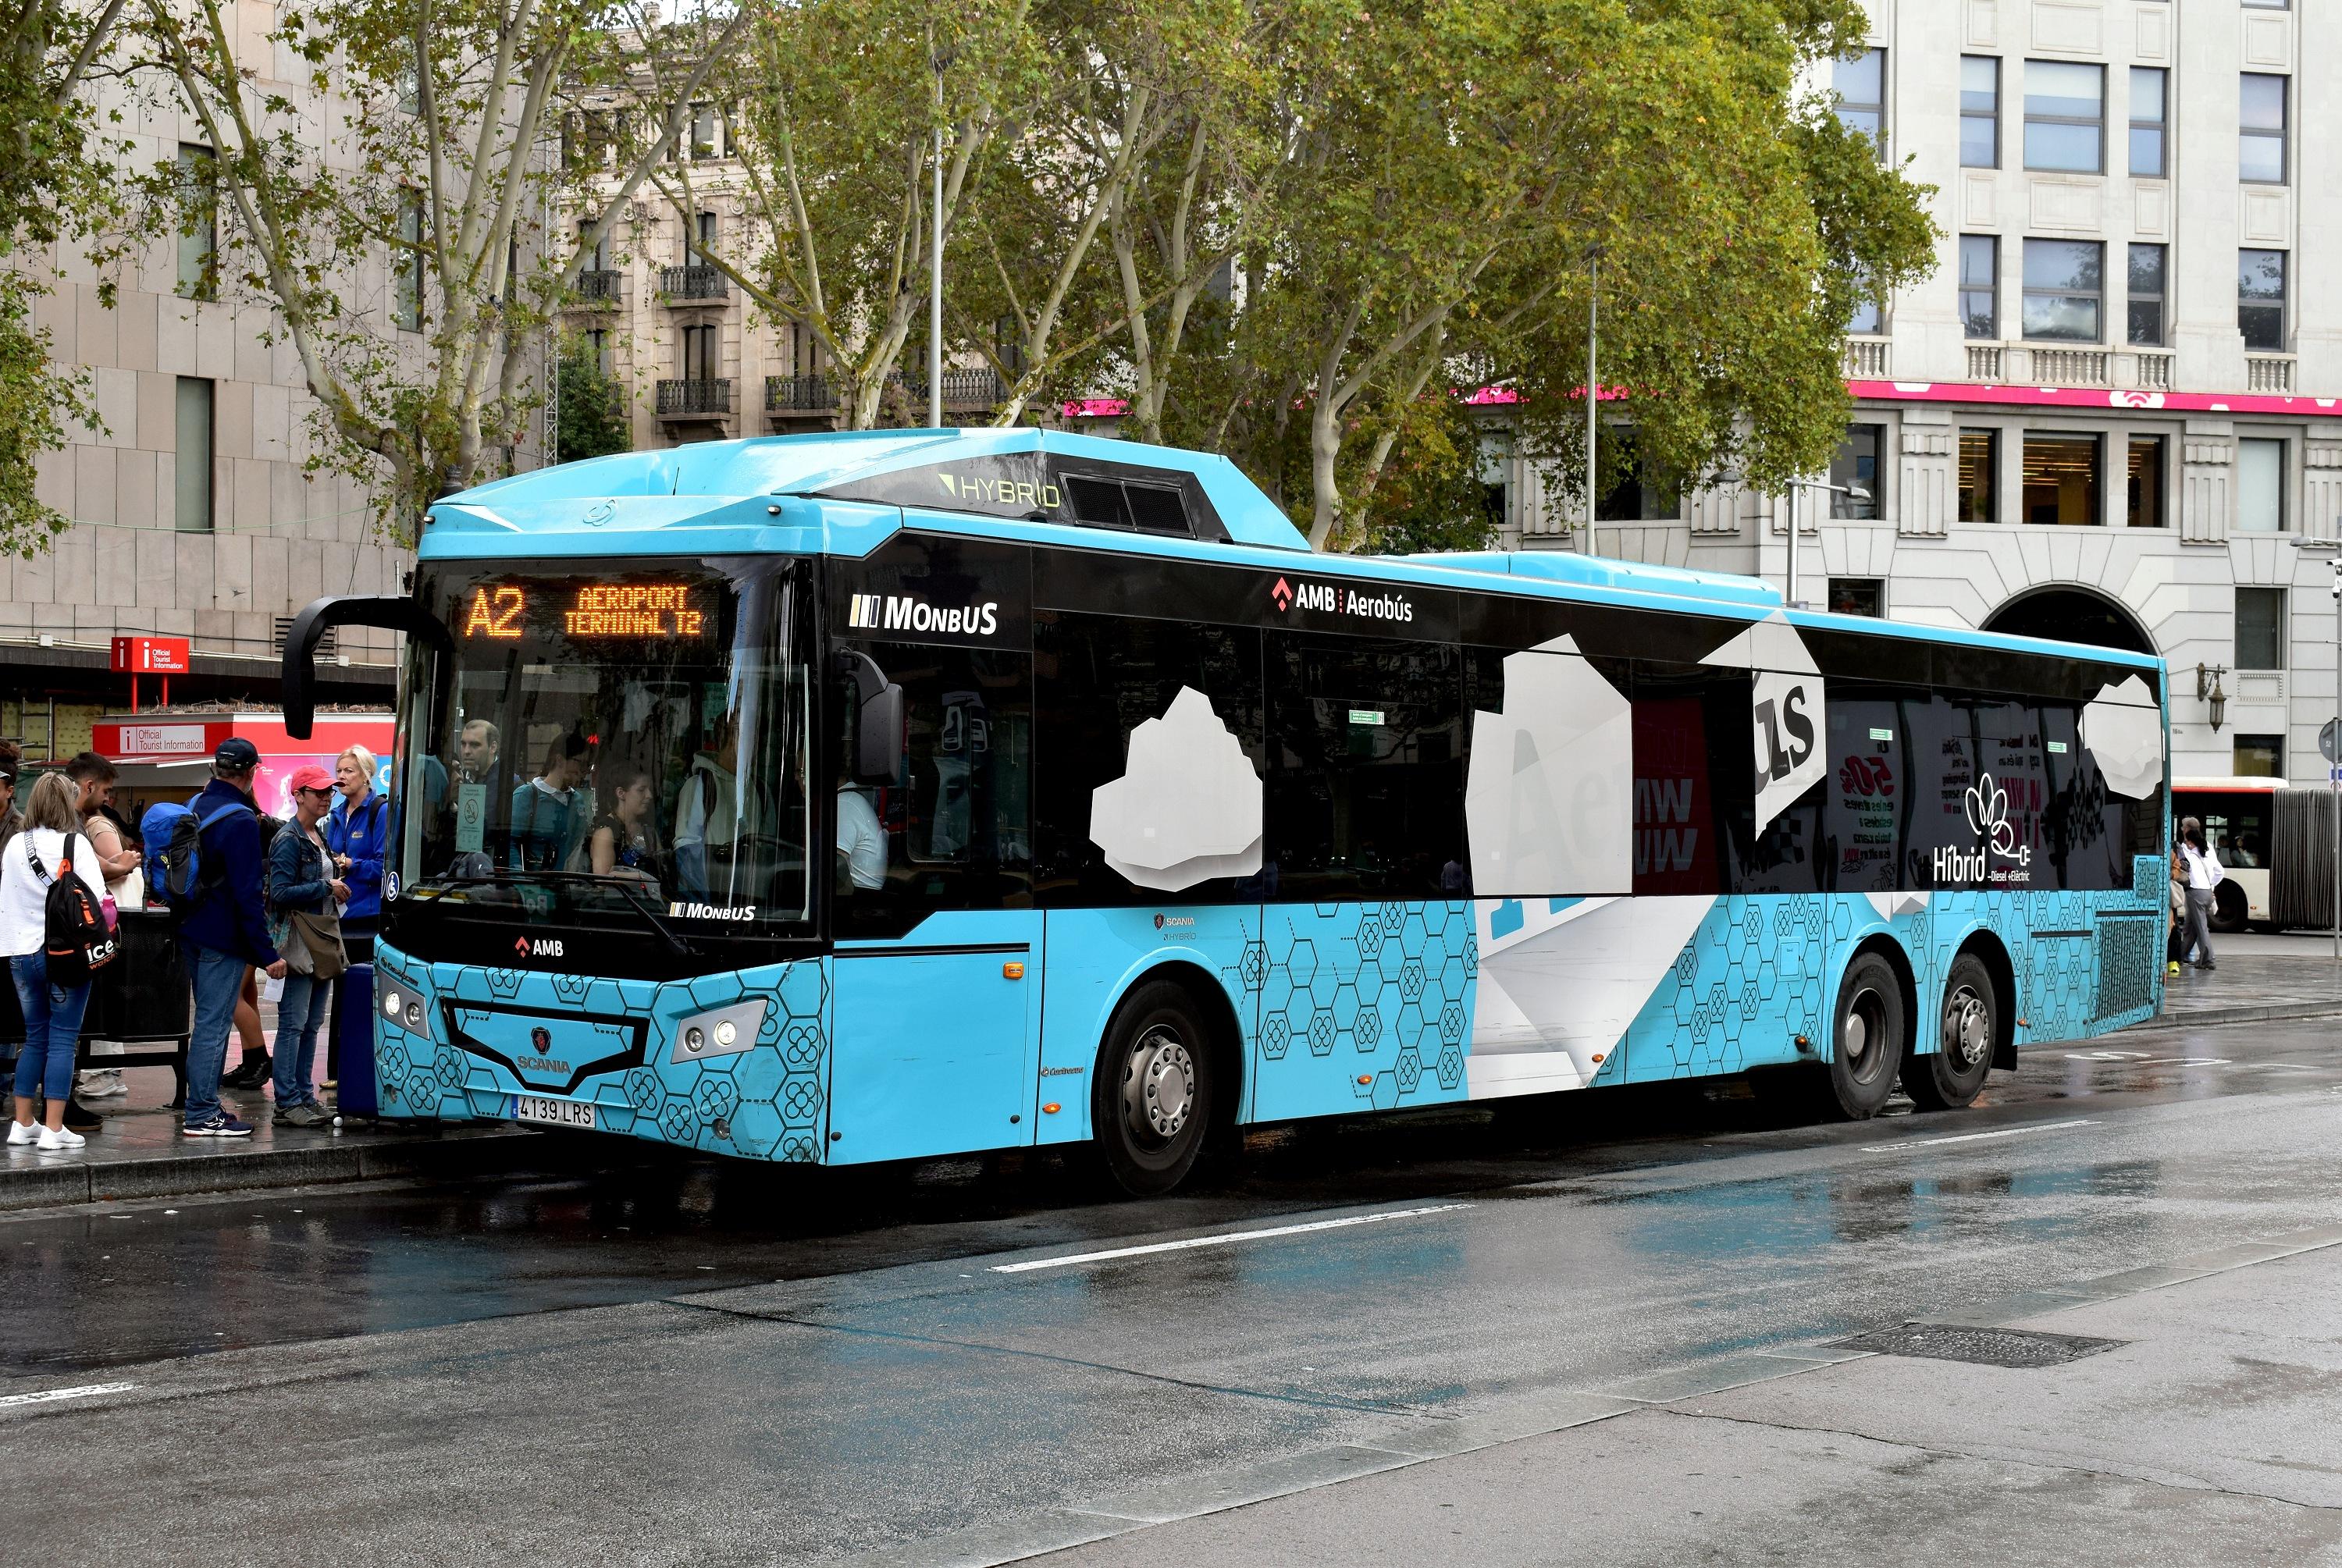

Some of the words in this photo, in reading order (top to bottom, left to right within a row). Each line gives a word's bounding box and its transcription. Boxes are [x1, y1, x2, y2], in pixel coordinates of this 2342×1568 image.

[961, 476, 1060, 508] HYBRID
[578, 586, 687, 610] AEROPORT
[1296, 583, 1336, 612] AMB
[1346, 589, 1413, 622] Aerobús
[465, 588, 523, 637] A2
[565, 611, 667, 634] TERMINAL
[674, 611, 701, 634] T2
[138, 729, 162, 739] Official
[140, 740, 162, 750] Tourist
[164, 740, 204, 750] Information
[1933, 844, 1986, 882] Híbrid
[1166, 917, 1195, 926] SCANIA
[1169, 931, 1197, 940] HYBRID
[86, 939, 115, 962] ice
[532, 939, 564, 957] AMB
[89, 952, 116, 970] watch
[517, 1055, 572, 1075] SCANIA
[520, 1097, 557, 1121] 4139
[563, 1102, 592, 1125] LRS
